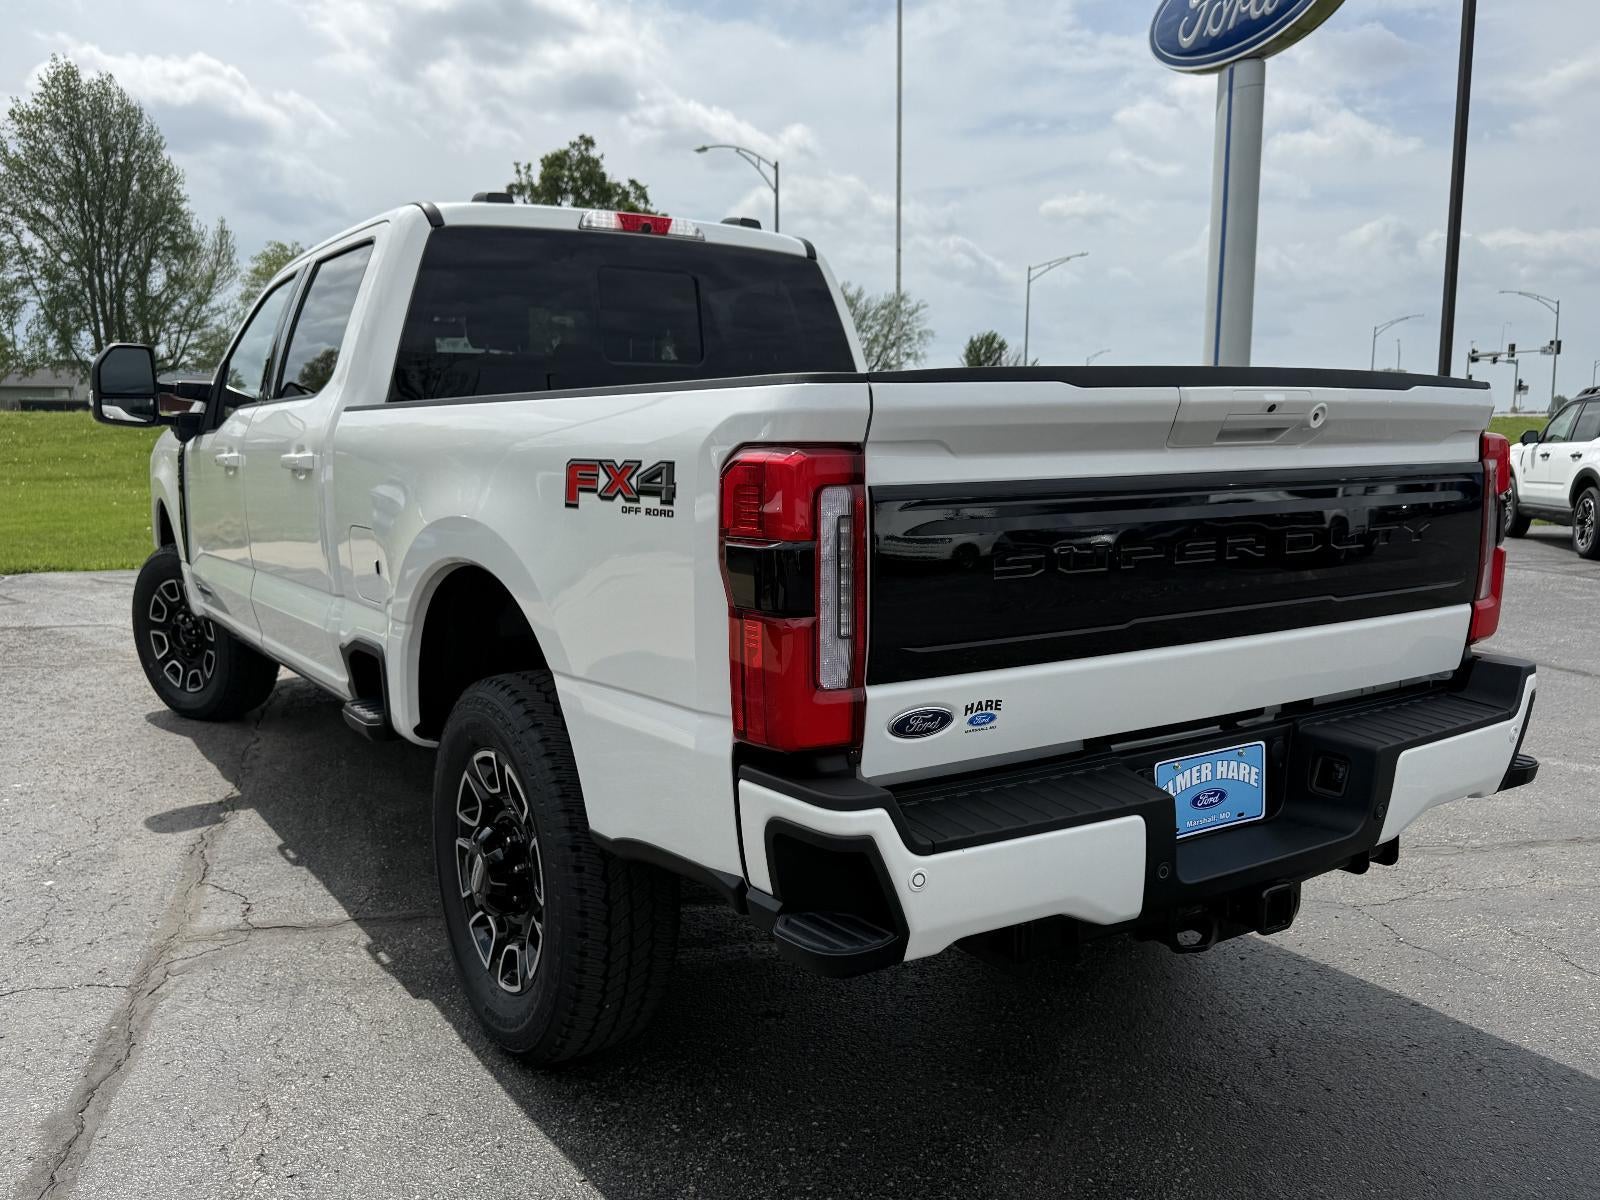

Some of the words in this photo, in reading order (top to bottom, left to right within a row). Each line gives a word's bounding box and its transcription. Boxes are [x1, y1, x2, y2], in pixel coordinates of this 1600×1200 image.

[565, 458, 676, 509] FX4
[621, 505, 642, 515] OFF
[645, 507, 674, 518] ROAD
[993, 535, 1265, 580] SUPER
[1286, 522, 1431, 554] DUTY
[964, 699, 1003, 716] HARE
[905, 713, 942, 733] Ford
[973, 715, 991, 725] Ford
[1163, 762, 1212, 797] LMER
[1216, 760, 1260, 787] HARE
[1197, 791, 1221, 807] Ford
[1186, 815, 1218, 828] Marshall,
[1219, 811, 1231, 819] MO
